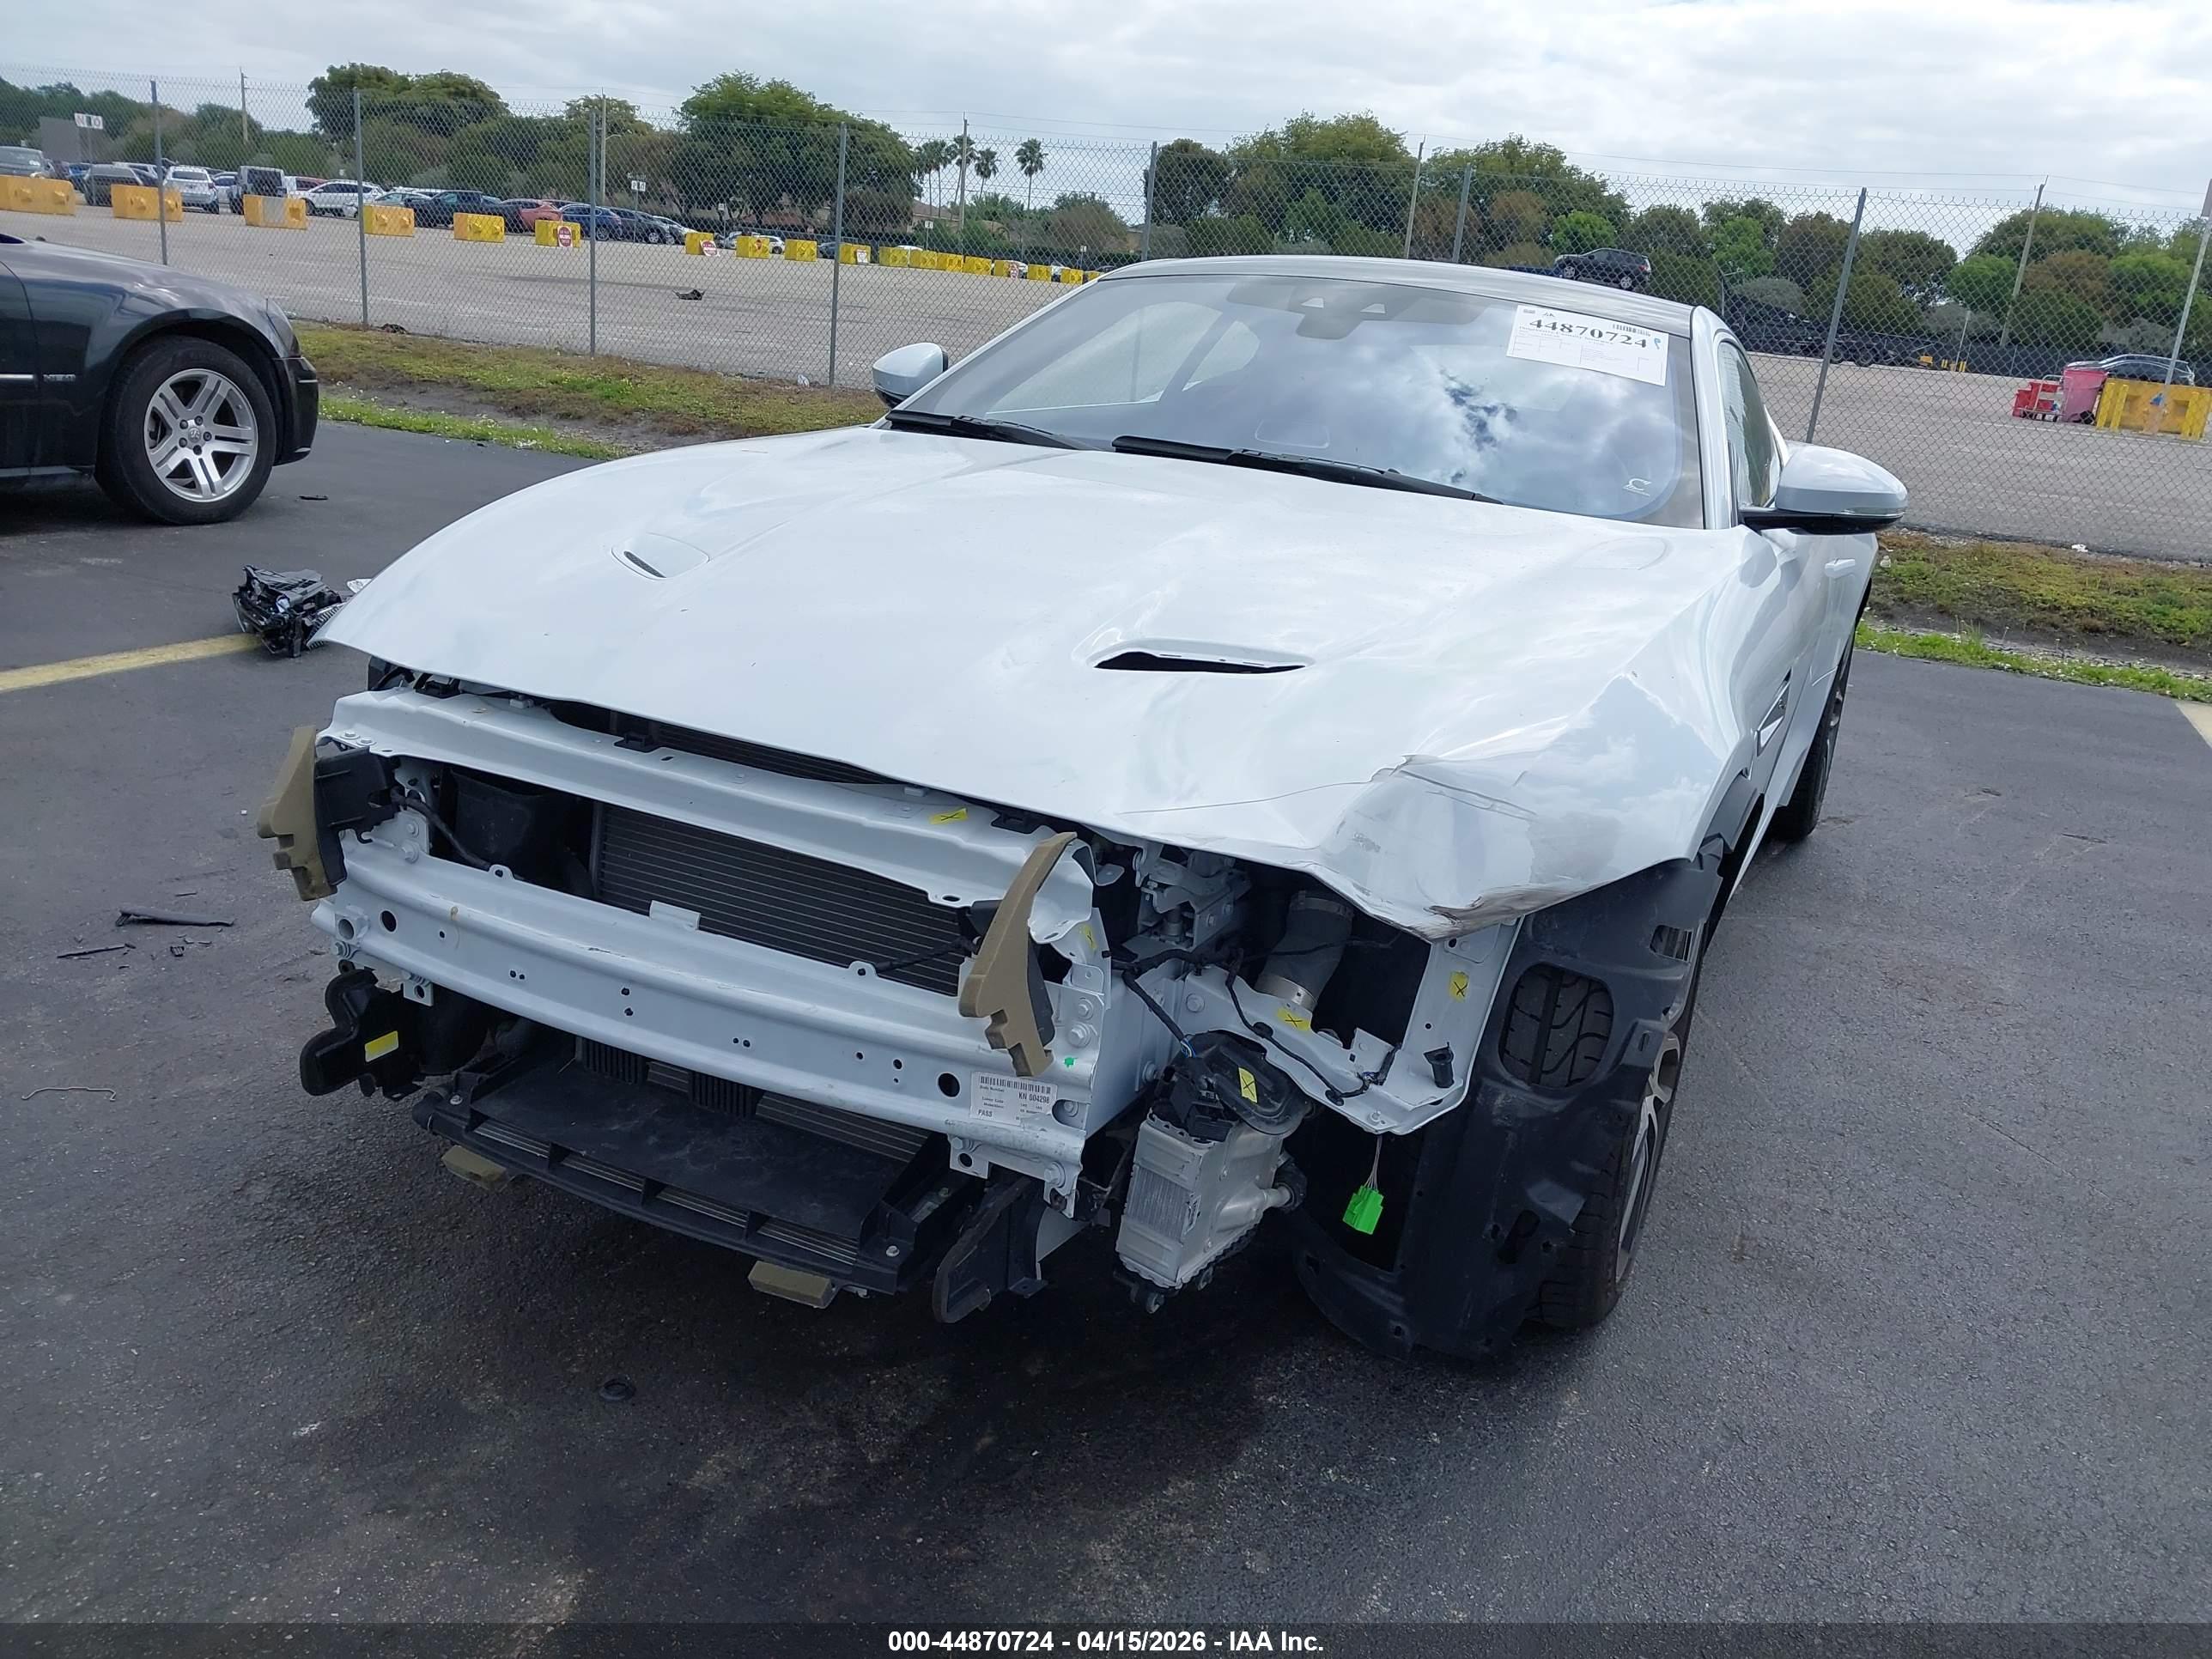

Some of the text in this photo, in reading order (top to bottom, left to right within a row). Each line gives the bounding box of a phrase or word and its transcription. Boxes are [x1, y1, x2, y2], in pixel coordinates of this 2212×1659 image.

[1529, 319, 1647, 348] 44870724
[1018, 1092, 1028, 1101] KN
[977, 1109, 993, 1118] PASS
